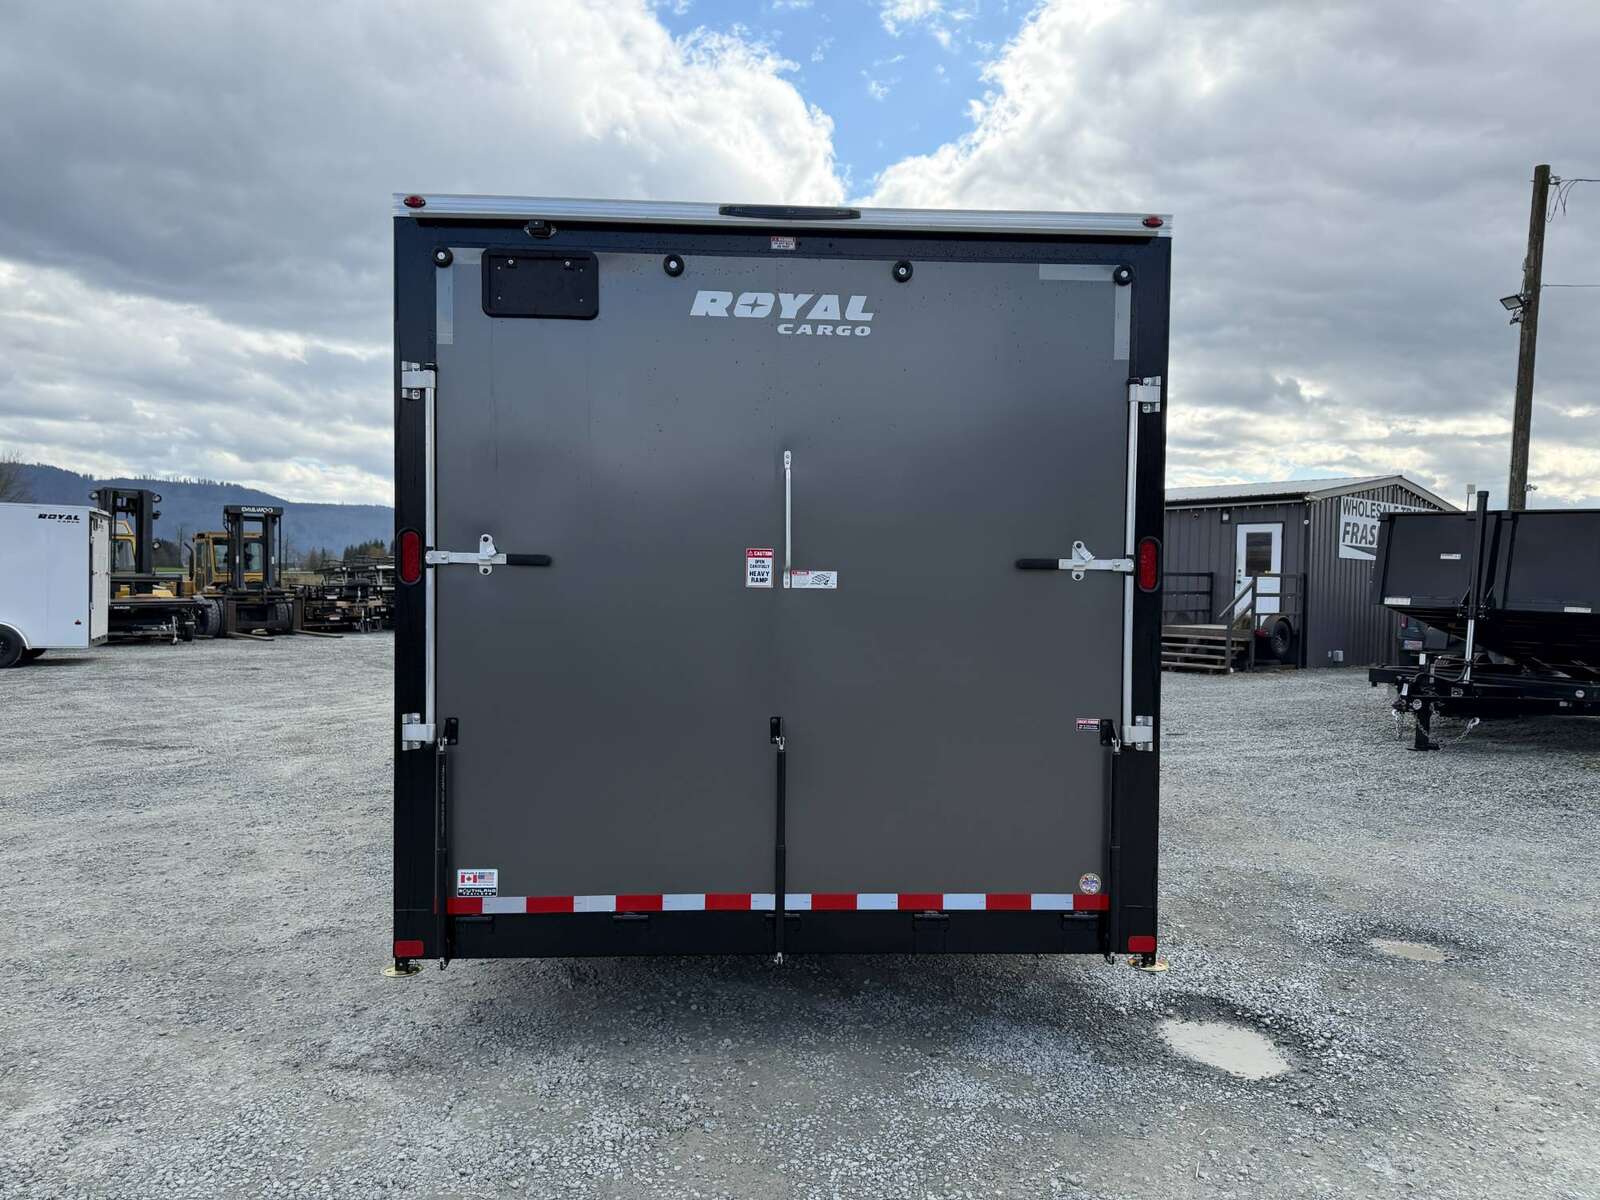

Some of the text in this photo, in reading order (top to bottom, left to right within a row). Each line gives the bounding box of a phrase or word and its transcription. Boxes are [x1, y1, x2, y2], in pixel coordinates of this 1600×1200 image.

[690, 290, 875, 321] ROYAL
[777, 323, 871, 337] CARGO
[1342, 521, 1379, 546] FRAS
